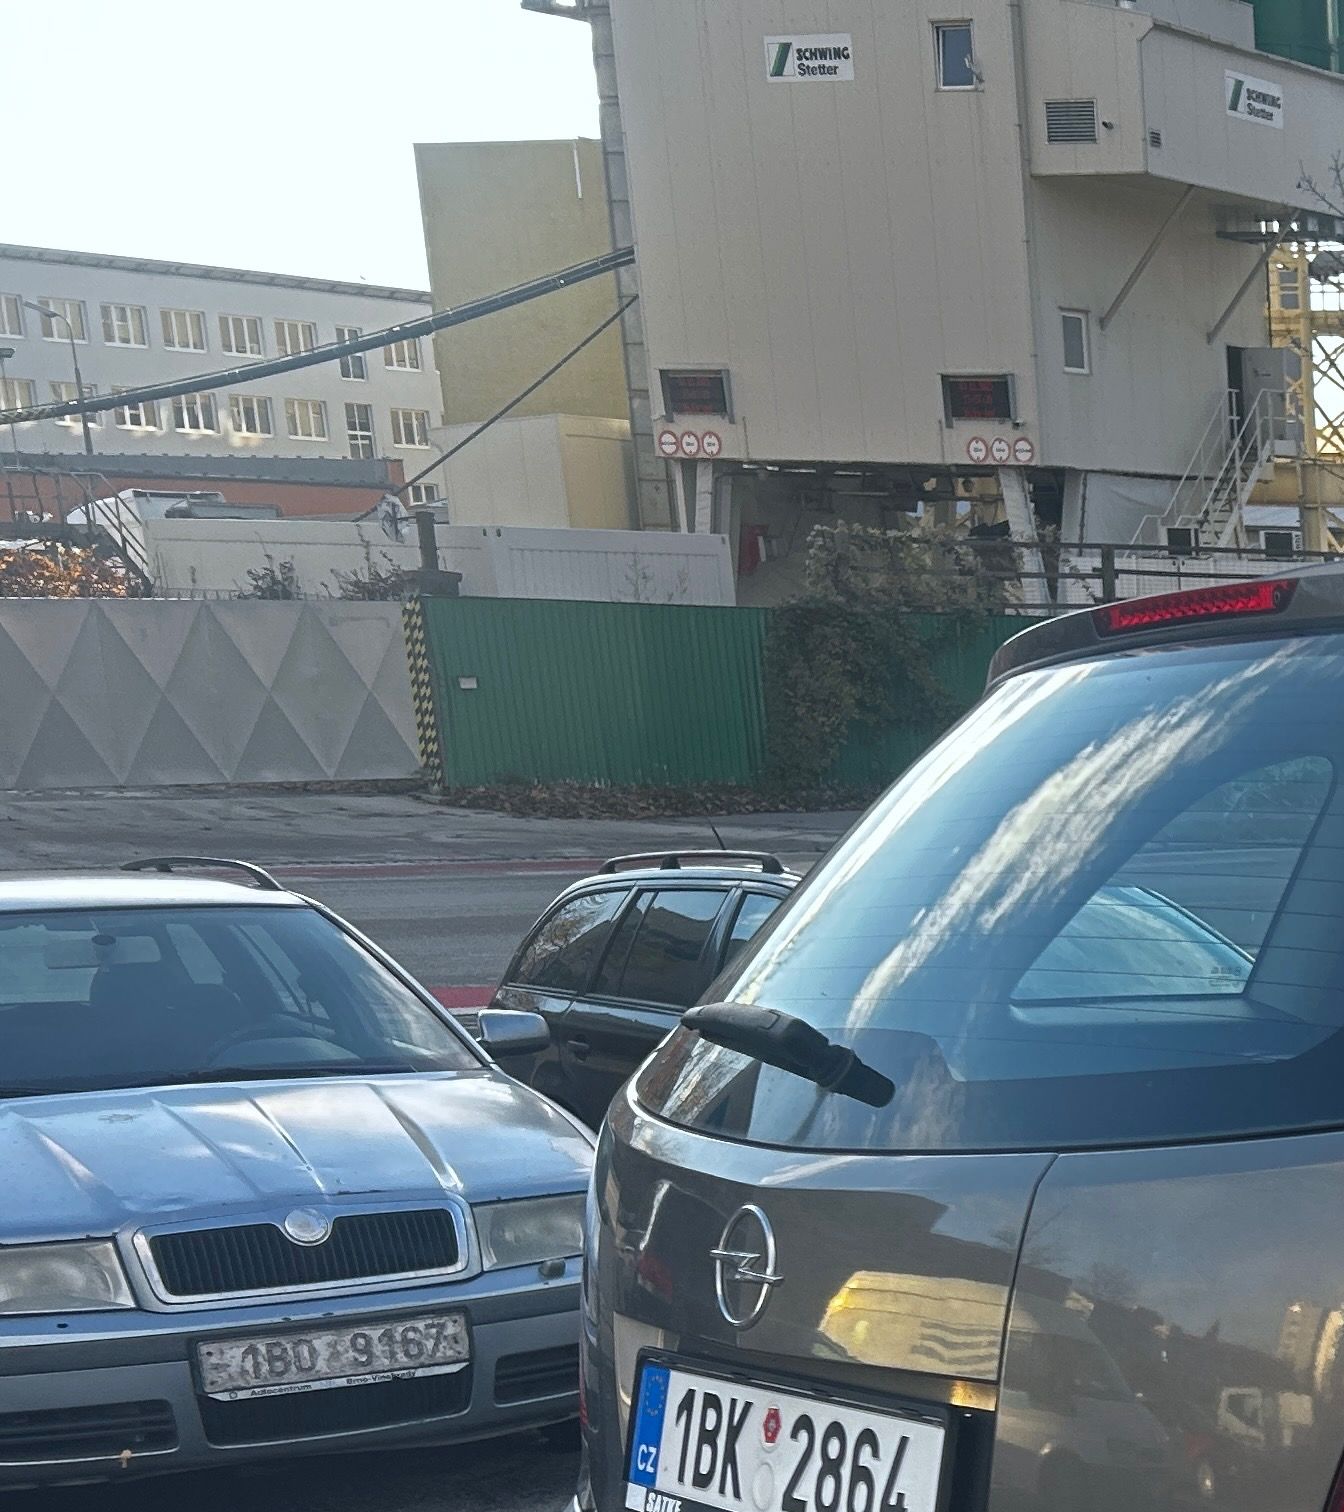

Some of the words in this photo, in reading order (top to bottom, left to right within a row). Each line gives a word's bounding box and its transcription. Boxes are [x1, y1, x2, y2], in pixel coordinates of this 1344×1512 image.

[796, 46, 850, 61] SCHWING
[797, 62, 839, 77] Stetter
[675, 1387, 754, 1501] 1BK
[636, 1443, 658, 1473] CZ
